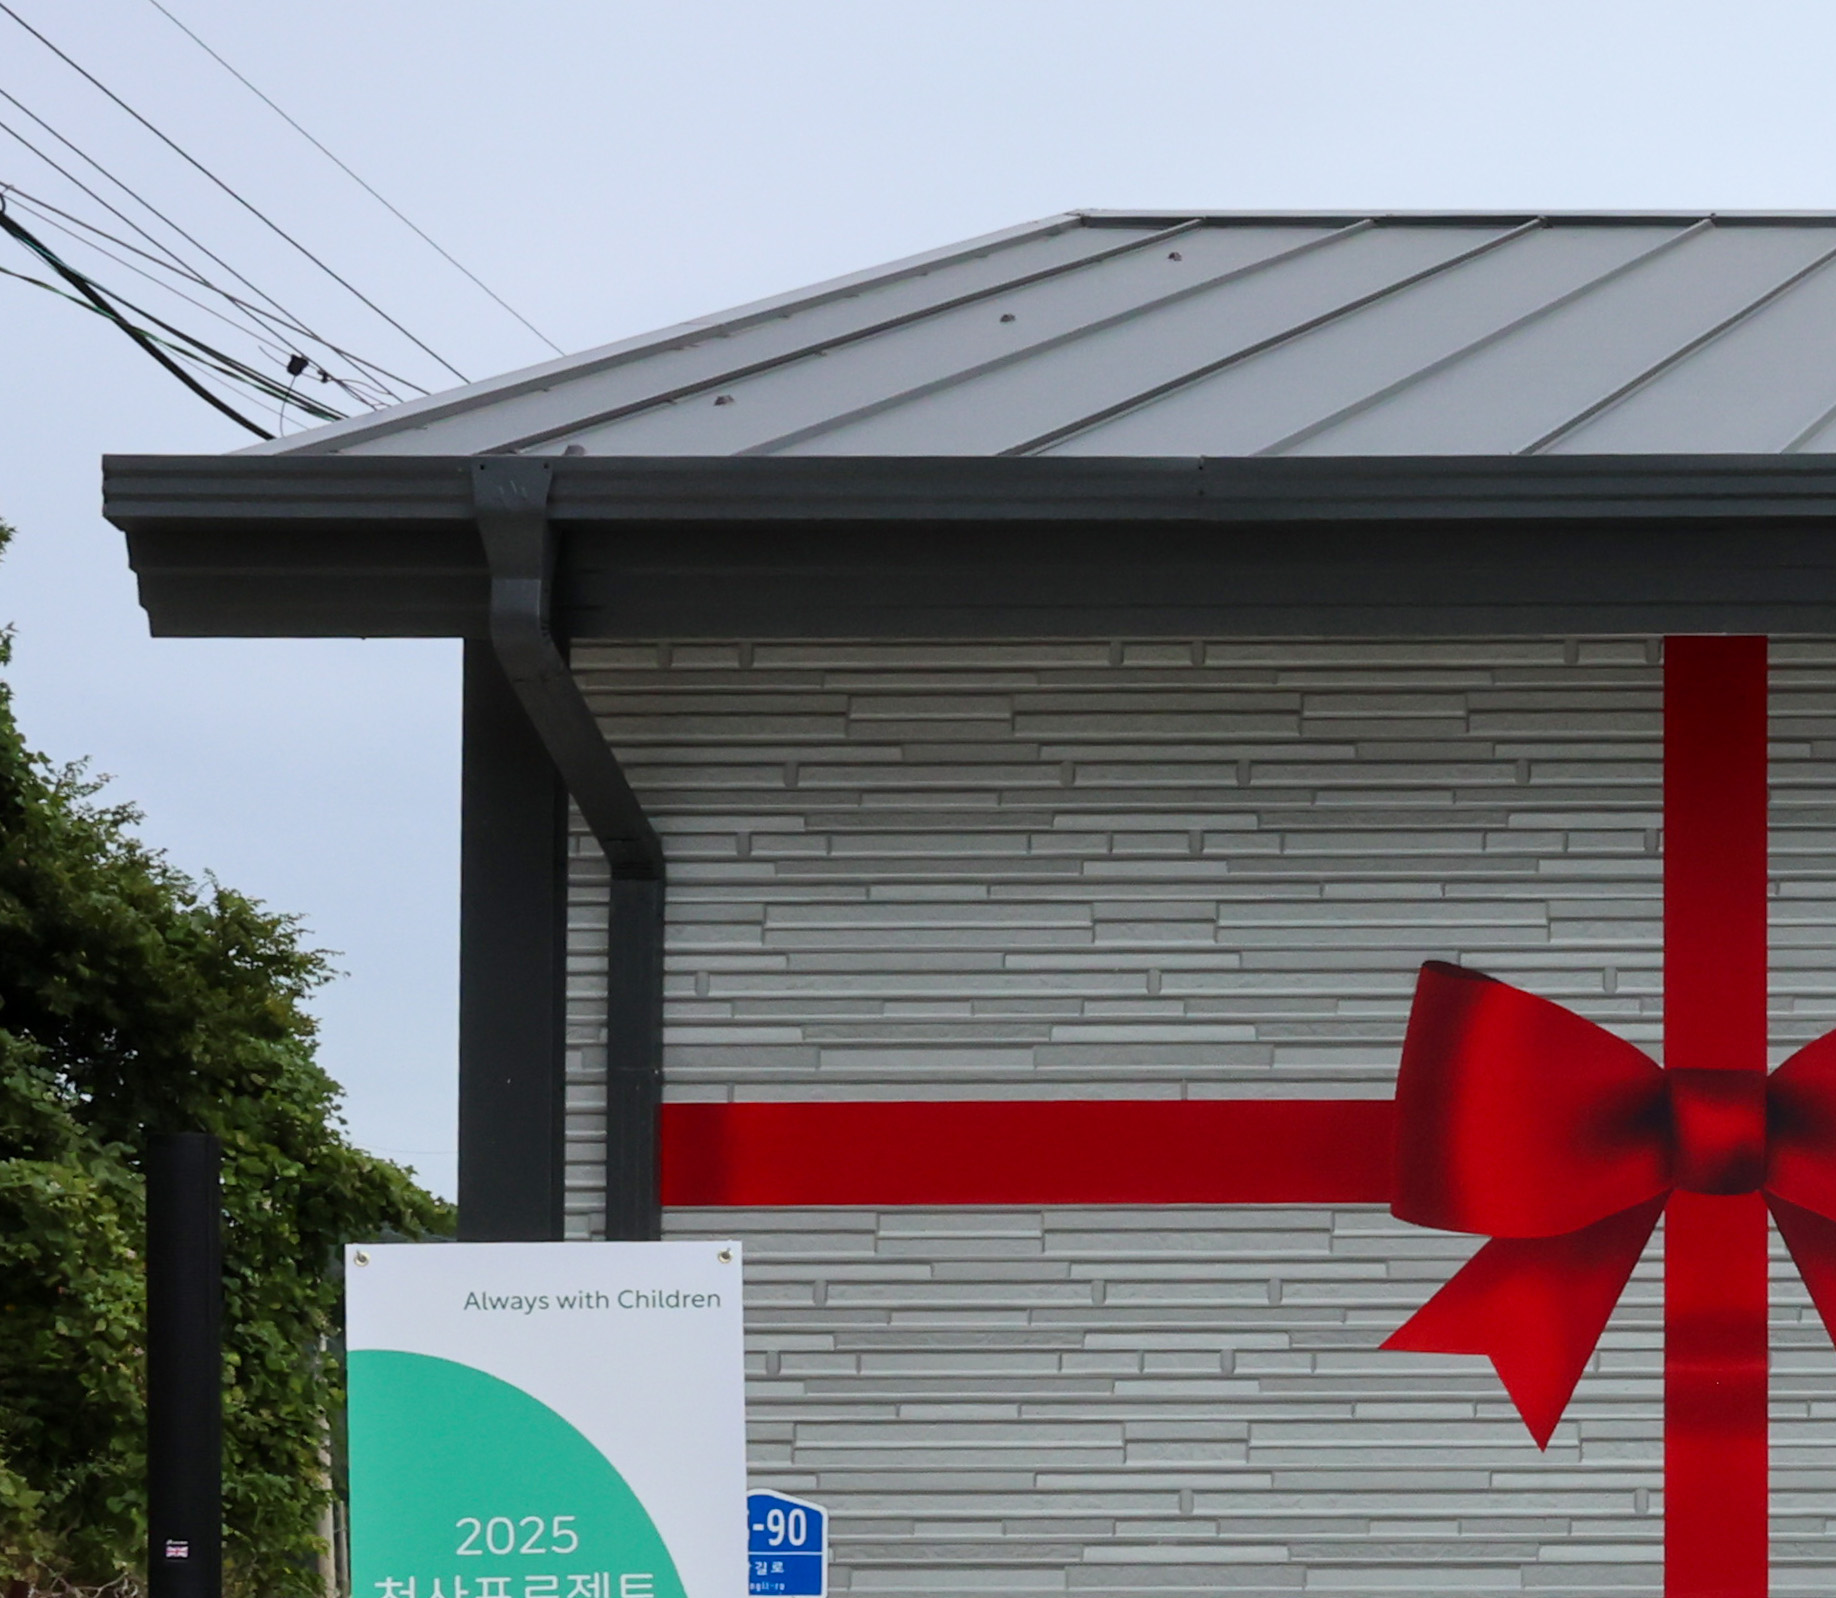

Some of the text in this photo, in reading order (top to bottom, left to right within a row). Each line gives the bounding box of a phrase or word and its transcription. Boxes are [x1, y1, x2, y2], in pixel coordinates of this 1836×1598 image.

[463, 1289, 721, 1316] Always with Children
[455, 1515, 579, 1556] 2025
[748, 1508, 806, 1546] -90
[753, 1561, 784, 1576] 길로
